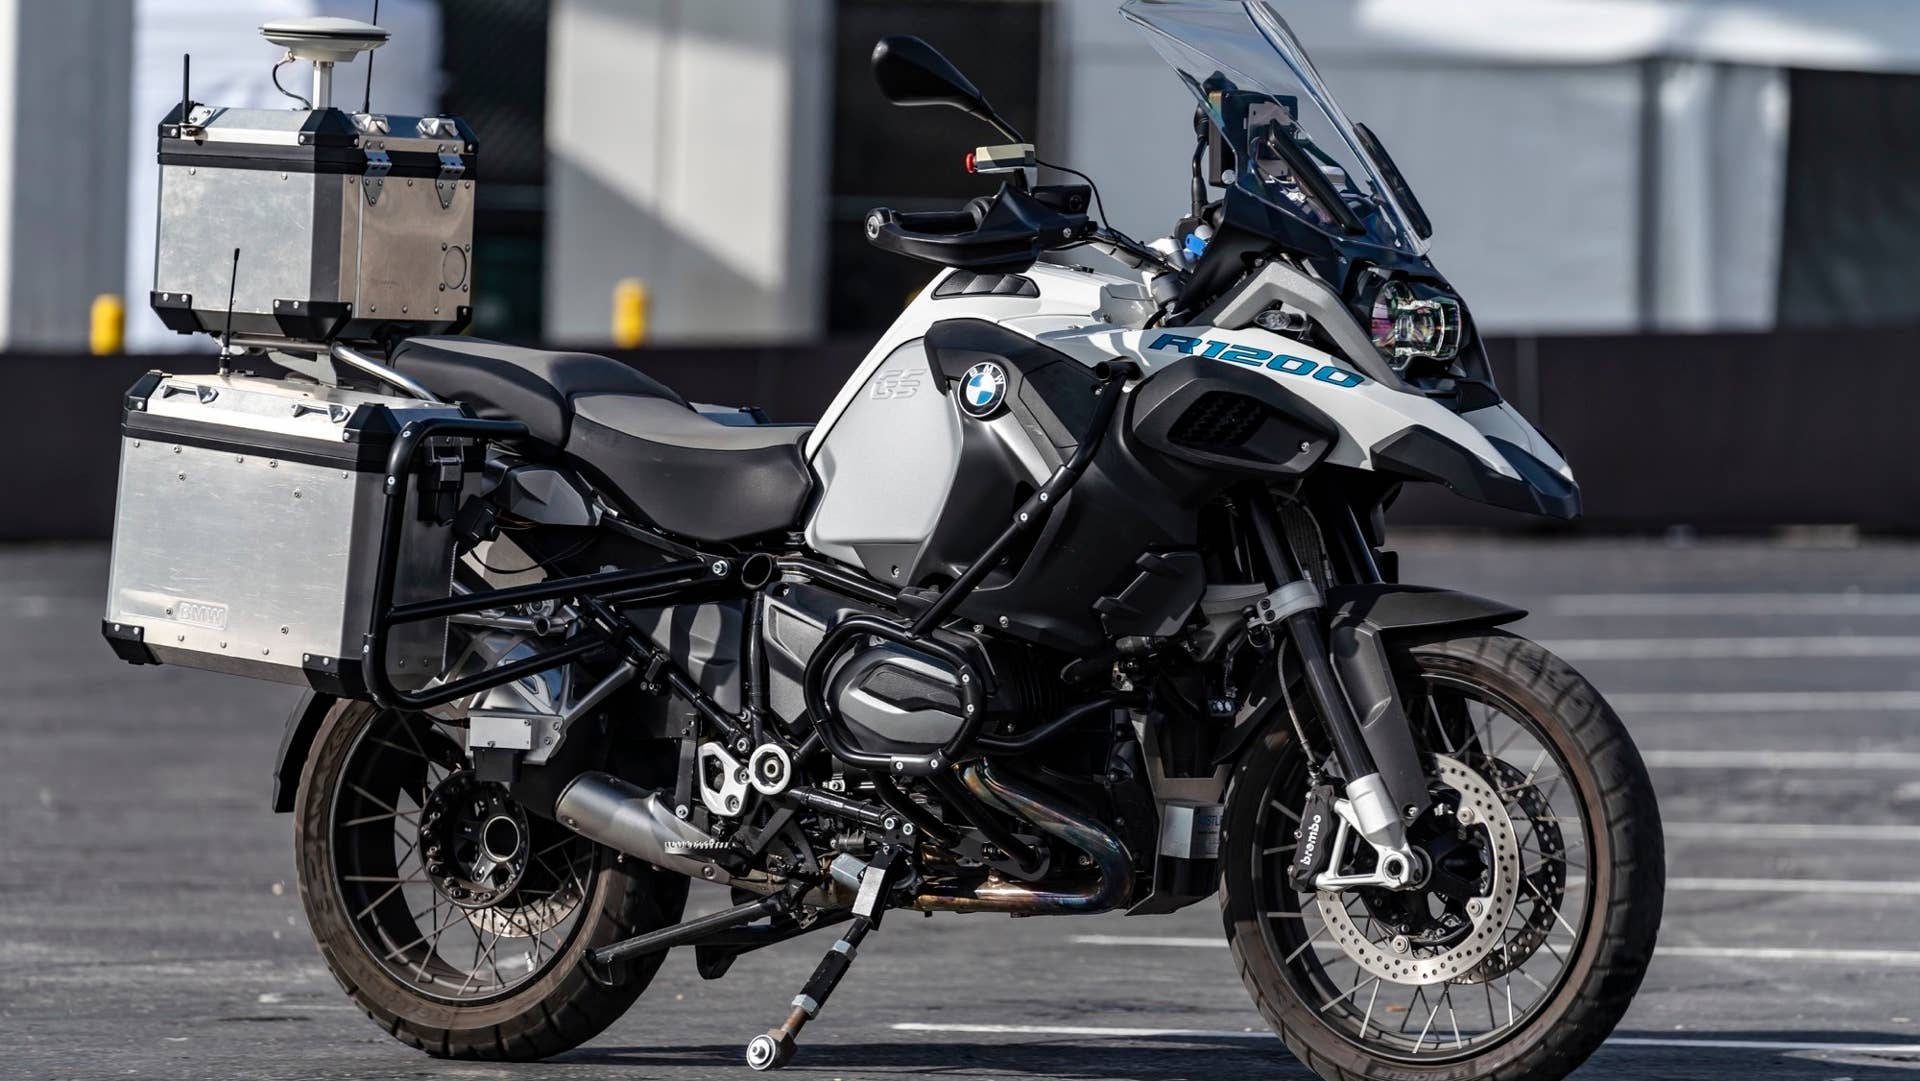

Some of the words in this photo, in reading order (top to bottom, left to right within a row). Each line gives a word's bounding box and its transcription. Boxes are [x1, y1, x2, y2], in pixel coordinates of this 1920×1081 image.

[968, 364, 1005, 385] BMW
[1148, 333, 1366, 388] R1200
[871, 368, 927, 400] GS
[180, 602, 225, 625] BMW
[1300, 814, 1322, 866] brembo
